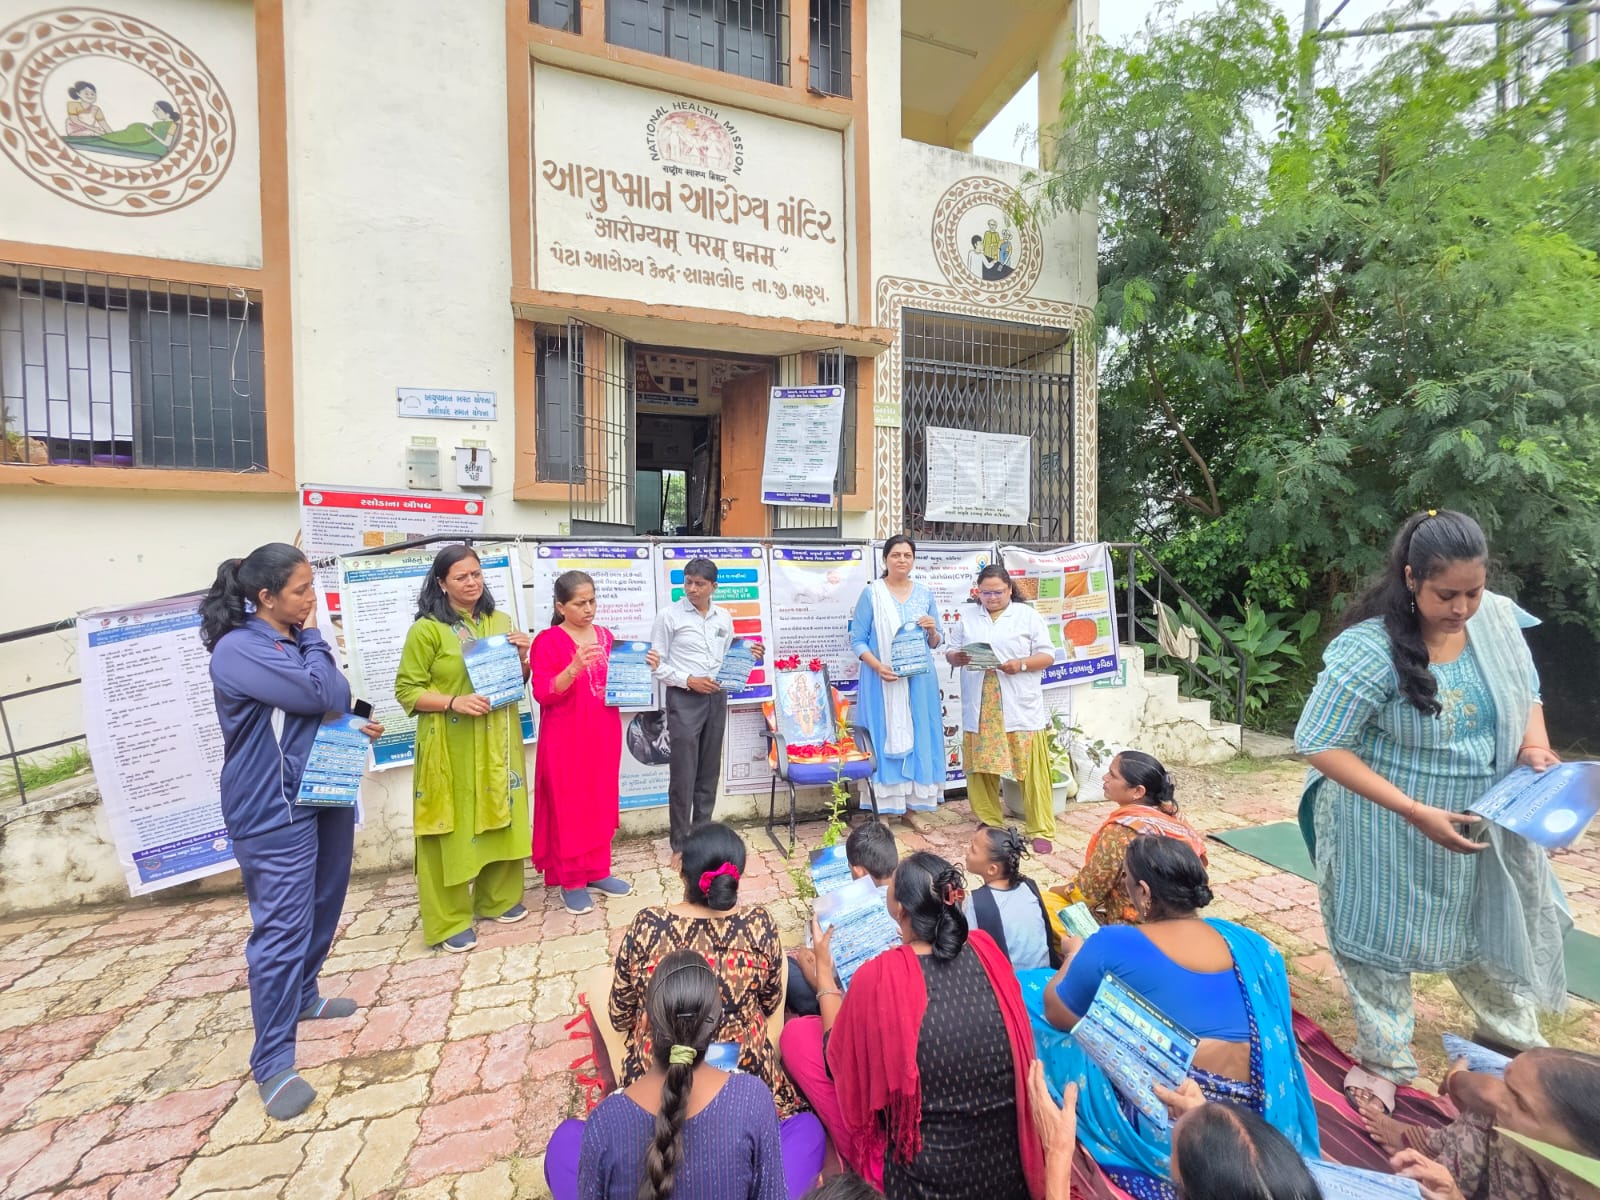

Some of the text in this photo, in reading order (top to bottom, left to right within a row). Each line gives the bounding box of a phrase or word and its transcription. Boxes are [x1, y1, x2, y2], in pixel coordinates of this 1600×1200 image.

[646, 101, 744, 176] NATIONAL HEALTH MISSION
[542, 159, 837, 244] આયુષ્માન આરોગ્ય મંદિર
[550, 240, 580, 266] પેટા
[584, 248, 644, 276] આરોગ્ય
[685, 231, 730, 264] परम्
[359, 497, 400, 508] રસોડાના
